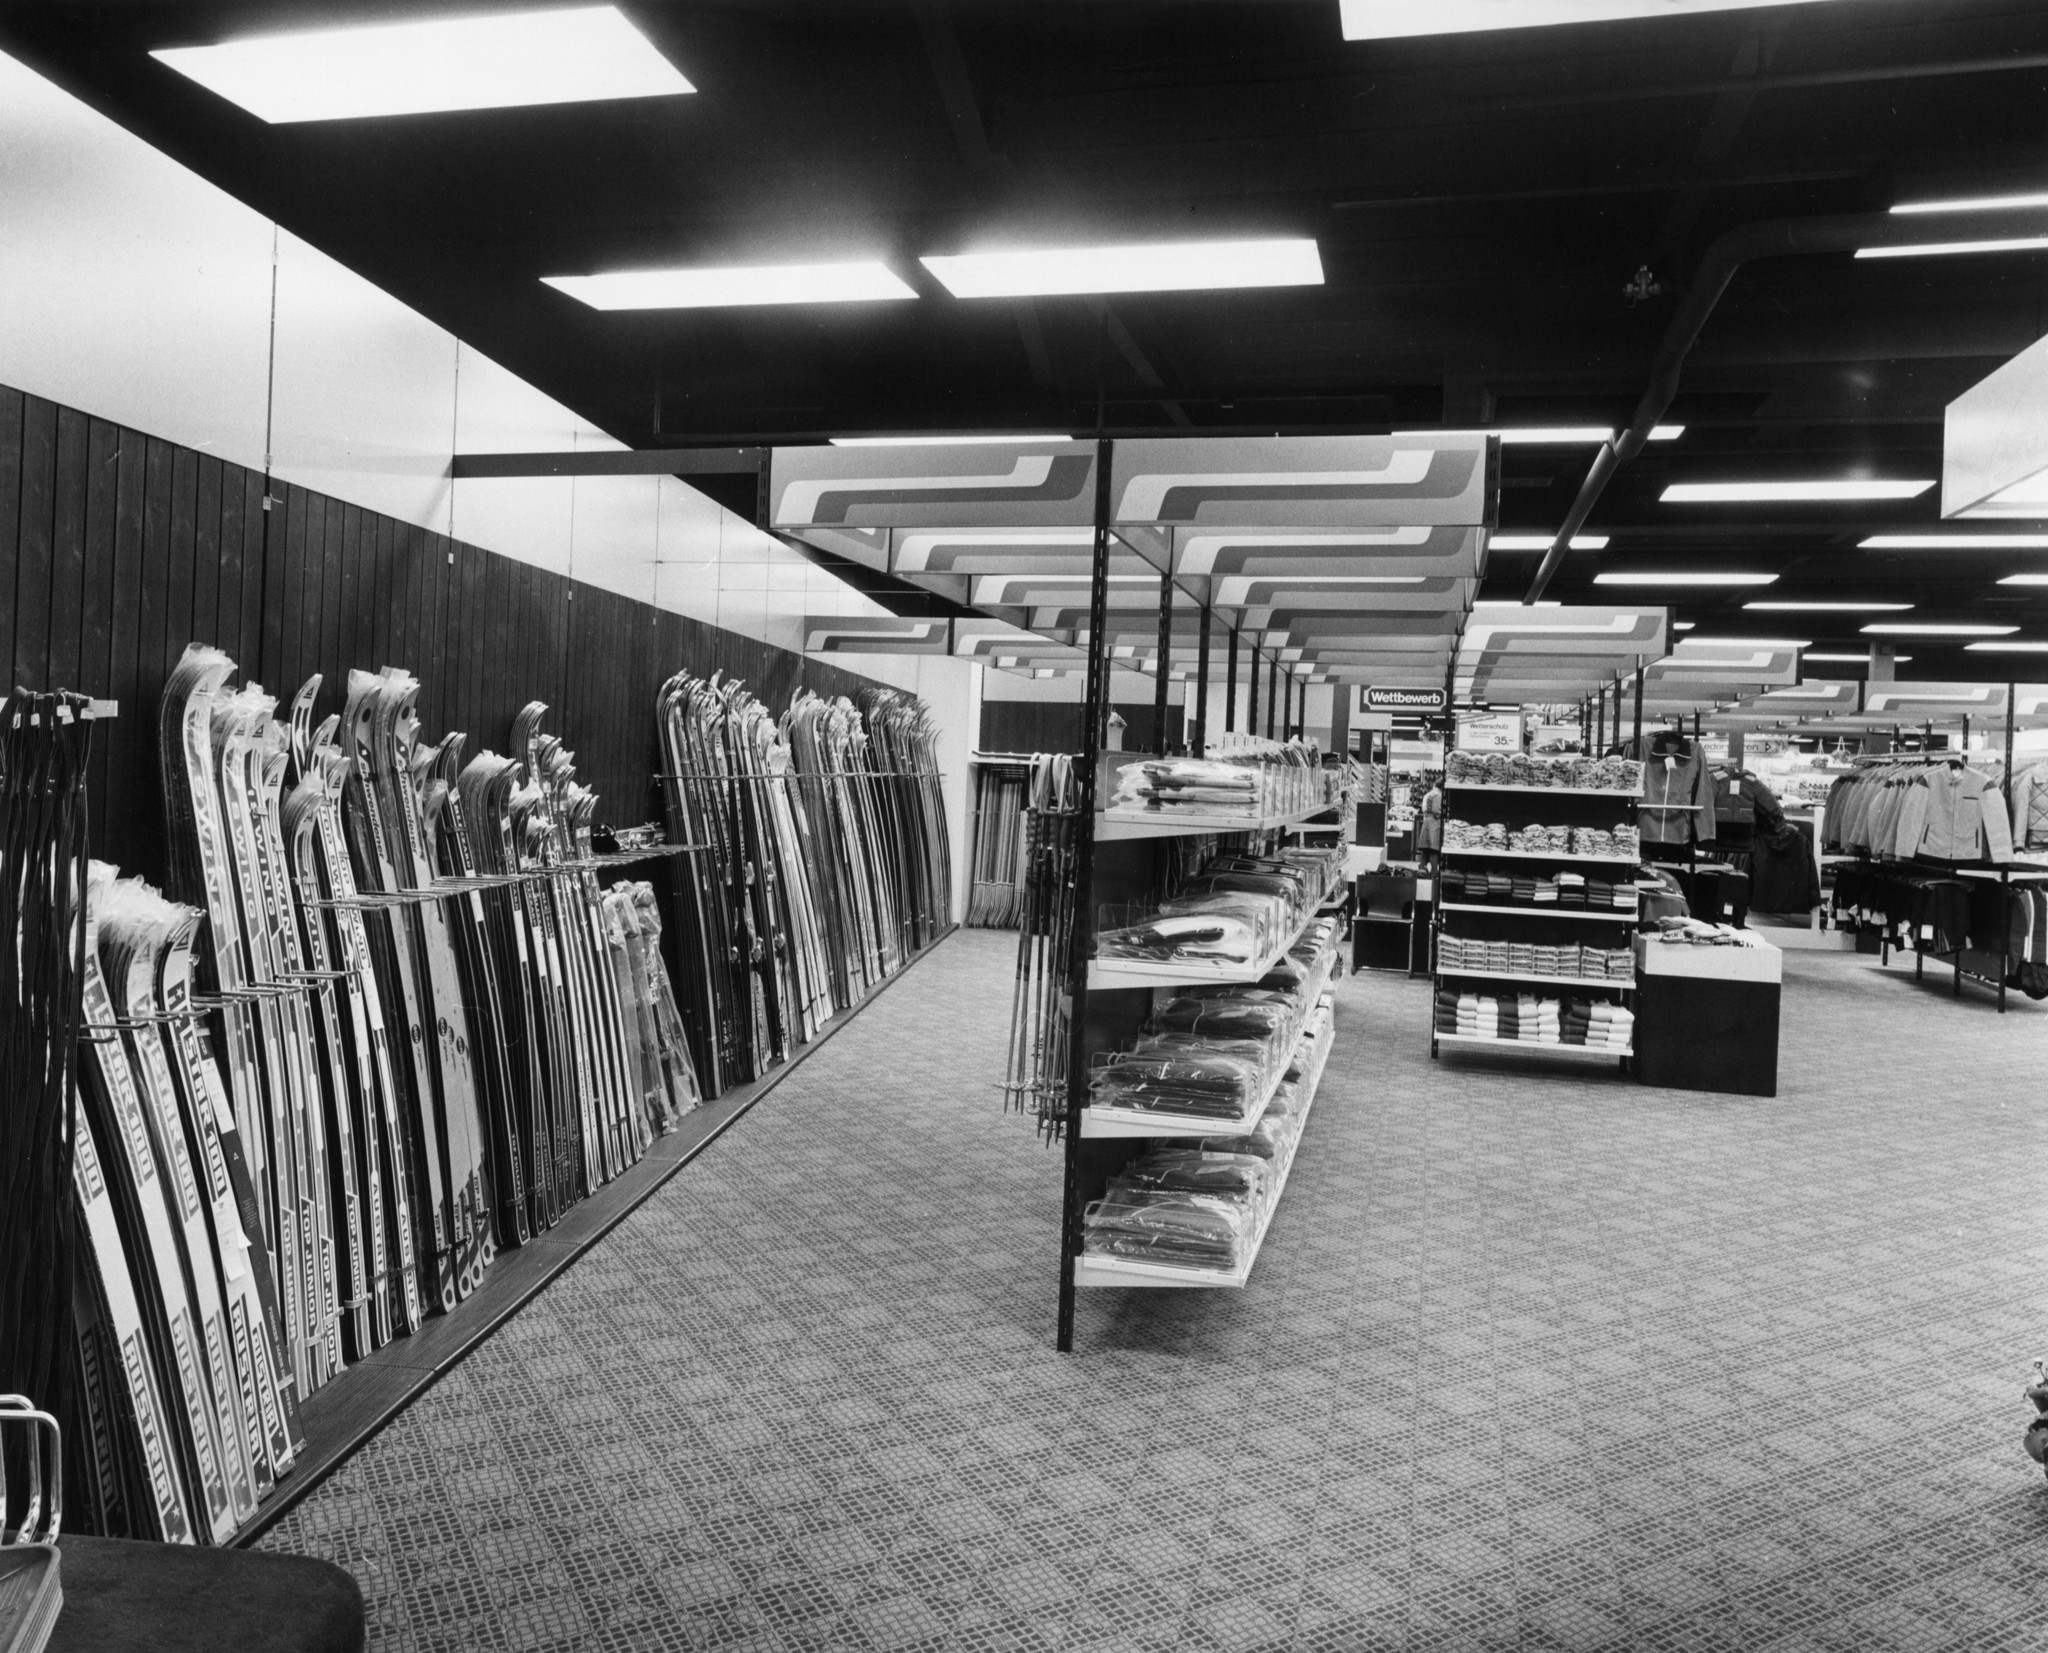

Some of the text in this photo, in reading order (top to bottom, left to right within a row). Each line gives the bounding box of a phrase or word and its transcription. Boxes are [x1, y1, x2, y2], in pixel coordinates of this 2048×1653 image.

[1371, 691, 1441, 704] Wettbewerb
[192, 774, 223, 926] SWING
[230, 800, 256, 920] SWING
[320, 808, 333, 845] TOP
[338, 851, 350, 885] OP
[452, 803, 472, 868] BLIZARD
[126, 1110, 153, 1174] 100
[183, 1035, 213, 1128] STAR
[204, 1130, 227, 1192] 100
[175, 1148, 199, 1210] 100
[347, 1198, 357, 1235] TOP
[282, 1214, 298, 1340] TOP JUNIOR
[302, 1204, 317, 1326] TOP JUNIOR
[321, 1243, 331, 1283] TOP
[80, 1335, 116, 1500] AUSTRIA
[171, 1320, 214, 1478] AUSTRIA
[204, 1323, 241, 1476] AUSTRIA
[230, 1305, 261, 1455] AUSTRIA
[248, 1332, 278, 1427] AUSTRIA
[267, 1305, 279, 1342] FISCHER
[275, 1343, 284, 1368] MADE
[282, 1382, 294, 1417] USTRIA
[121, 1339, 172, 1503] AUSTRIA
